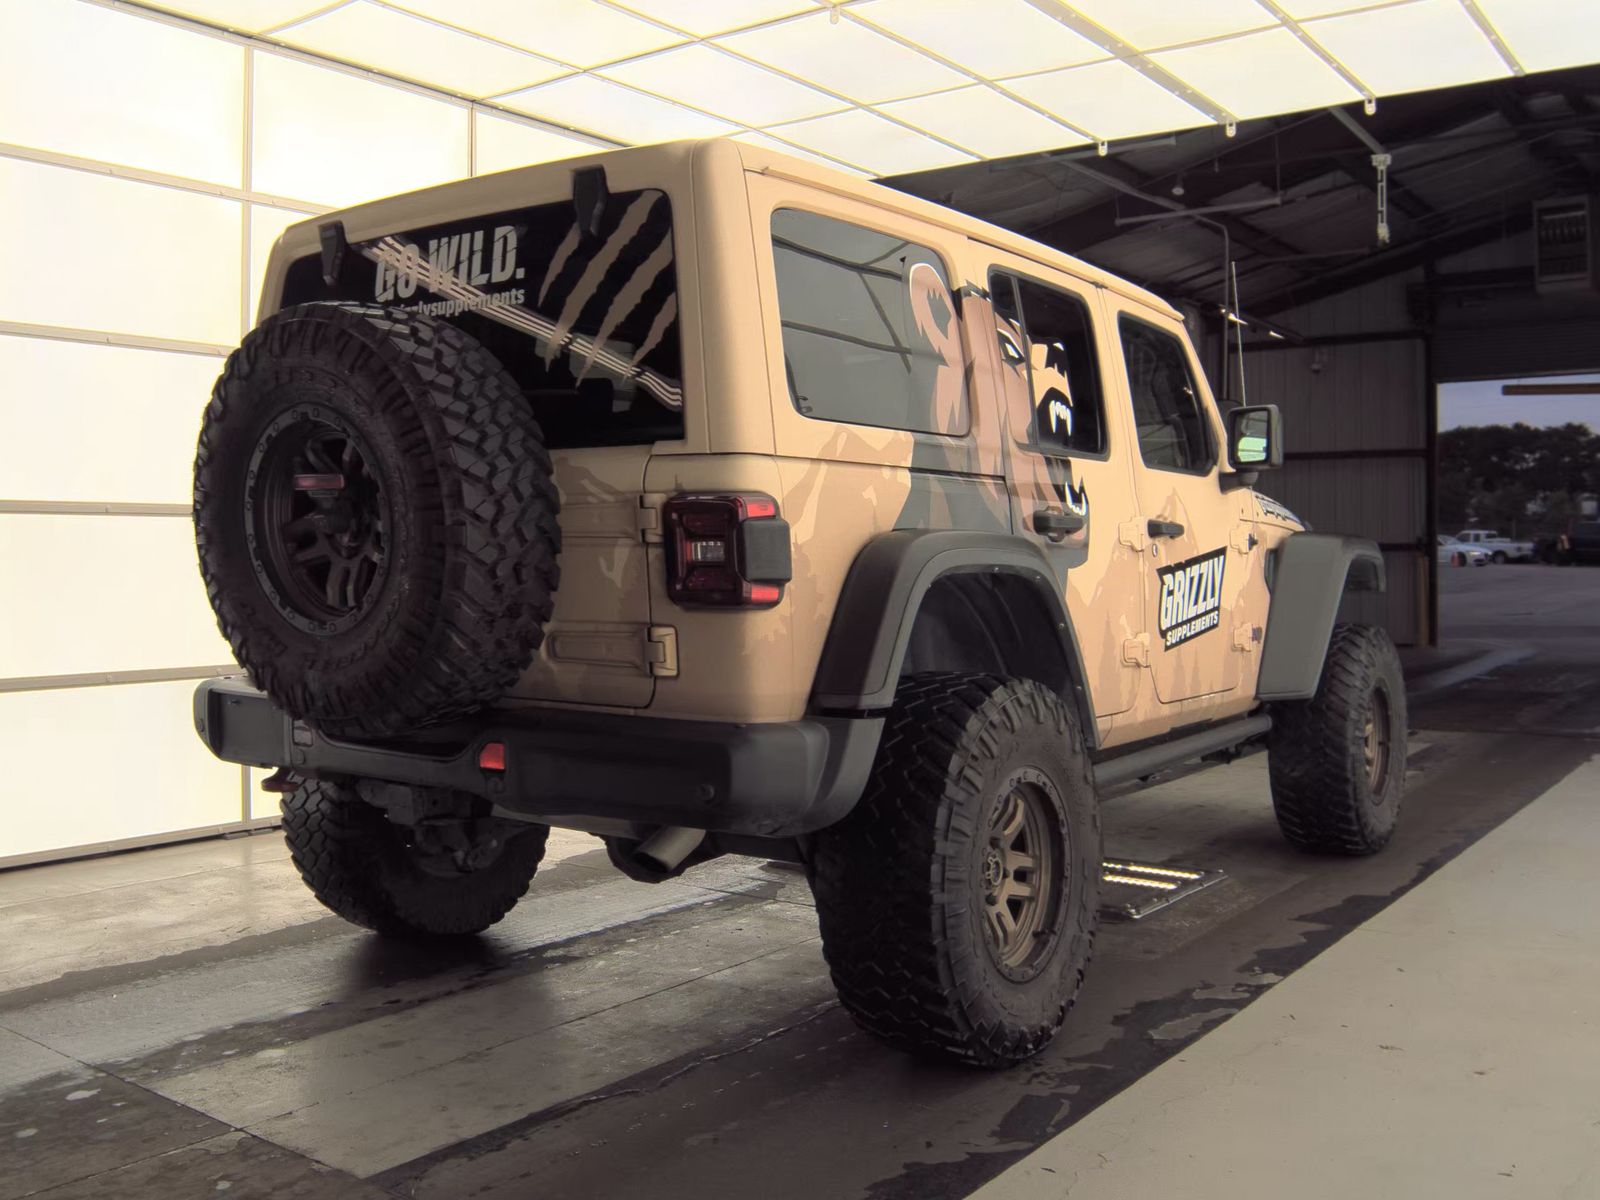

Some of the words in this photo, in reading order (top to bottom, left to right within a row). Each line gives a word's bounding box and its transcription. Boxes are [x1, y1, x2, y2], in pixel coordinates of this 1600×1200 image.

[375, 244, 420, 302] GO
[429, 225, 525, 293] WILD.
[1160, 554, 1225, 631] GRIZZLY
[1166, 610, 1219, 647] SUPPLEMENTS
